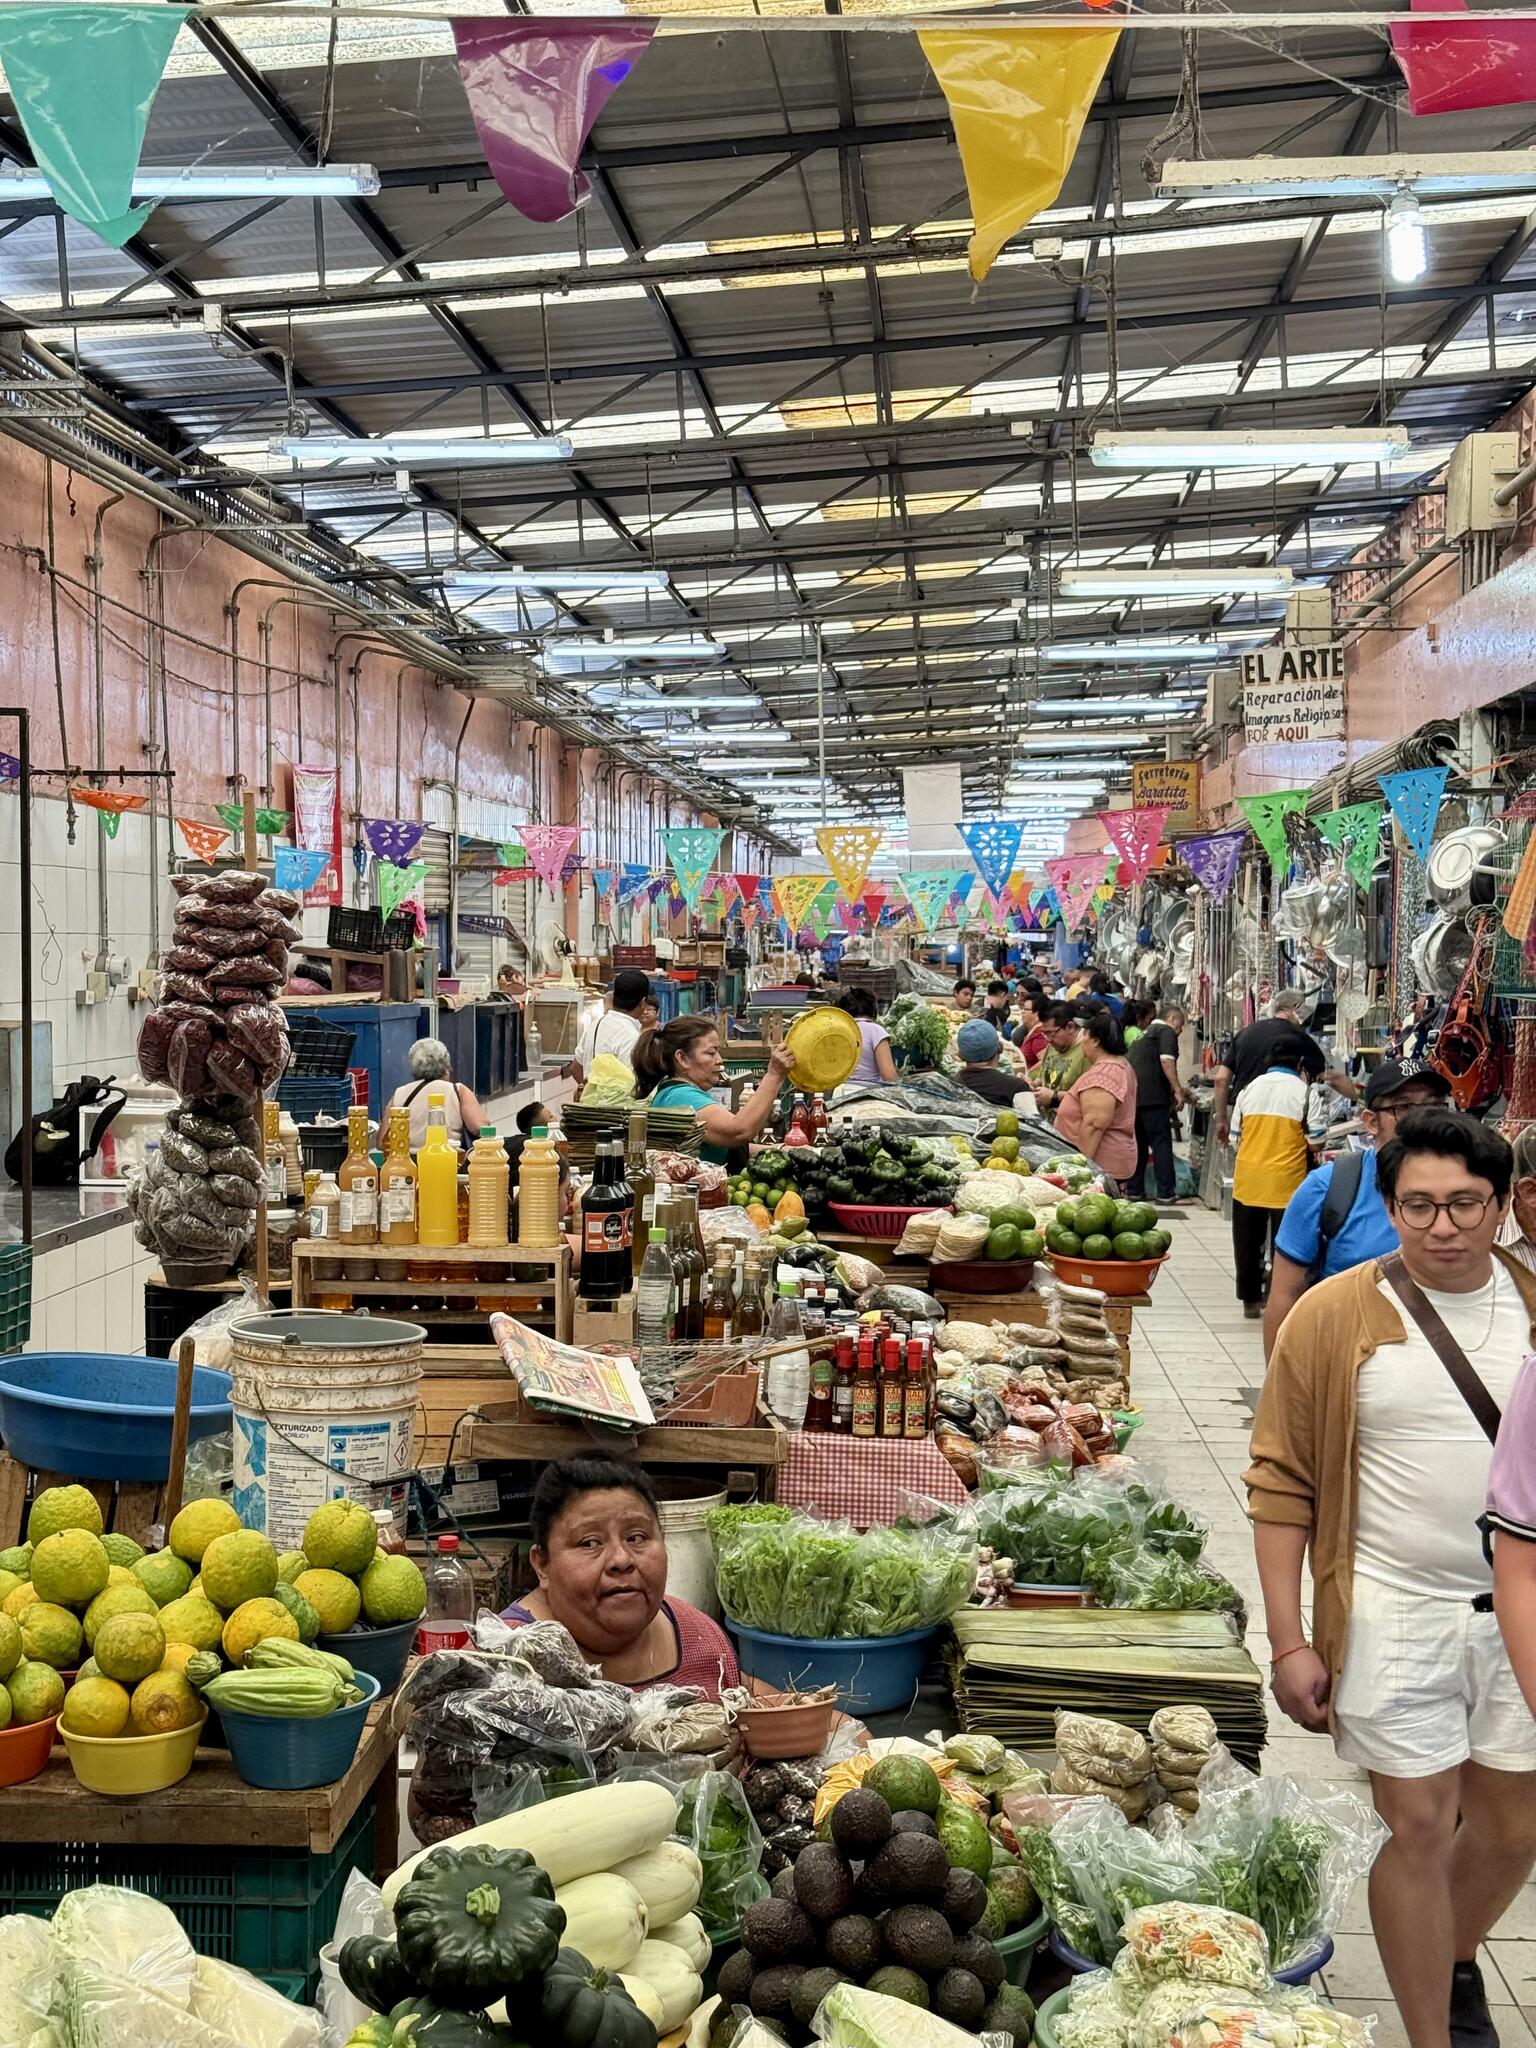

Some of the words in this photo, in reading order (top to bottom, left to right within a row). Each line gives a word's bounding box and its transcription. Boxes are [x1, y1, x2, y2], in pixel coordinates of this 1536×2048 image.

[1243, 653, 1271, 684] EL
[1278, 647, 1344, 681] ARTE
[1245, 685, 1322, 709] Reparación
[1324, 685, 1339, 700] de
[1245, 711, 1292, 729] Imagenes
[1246, 728, 1269, 743] POR
[1275, 725, 1309, 742] AQUI
